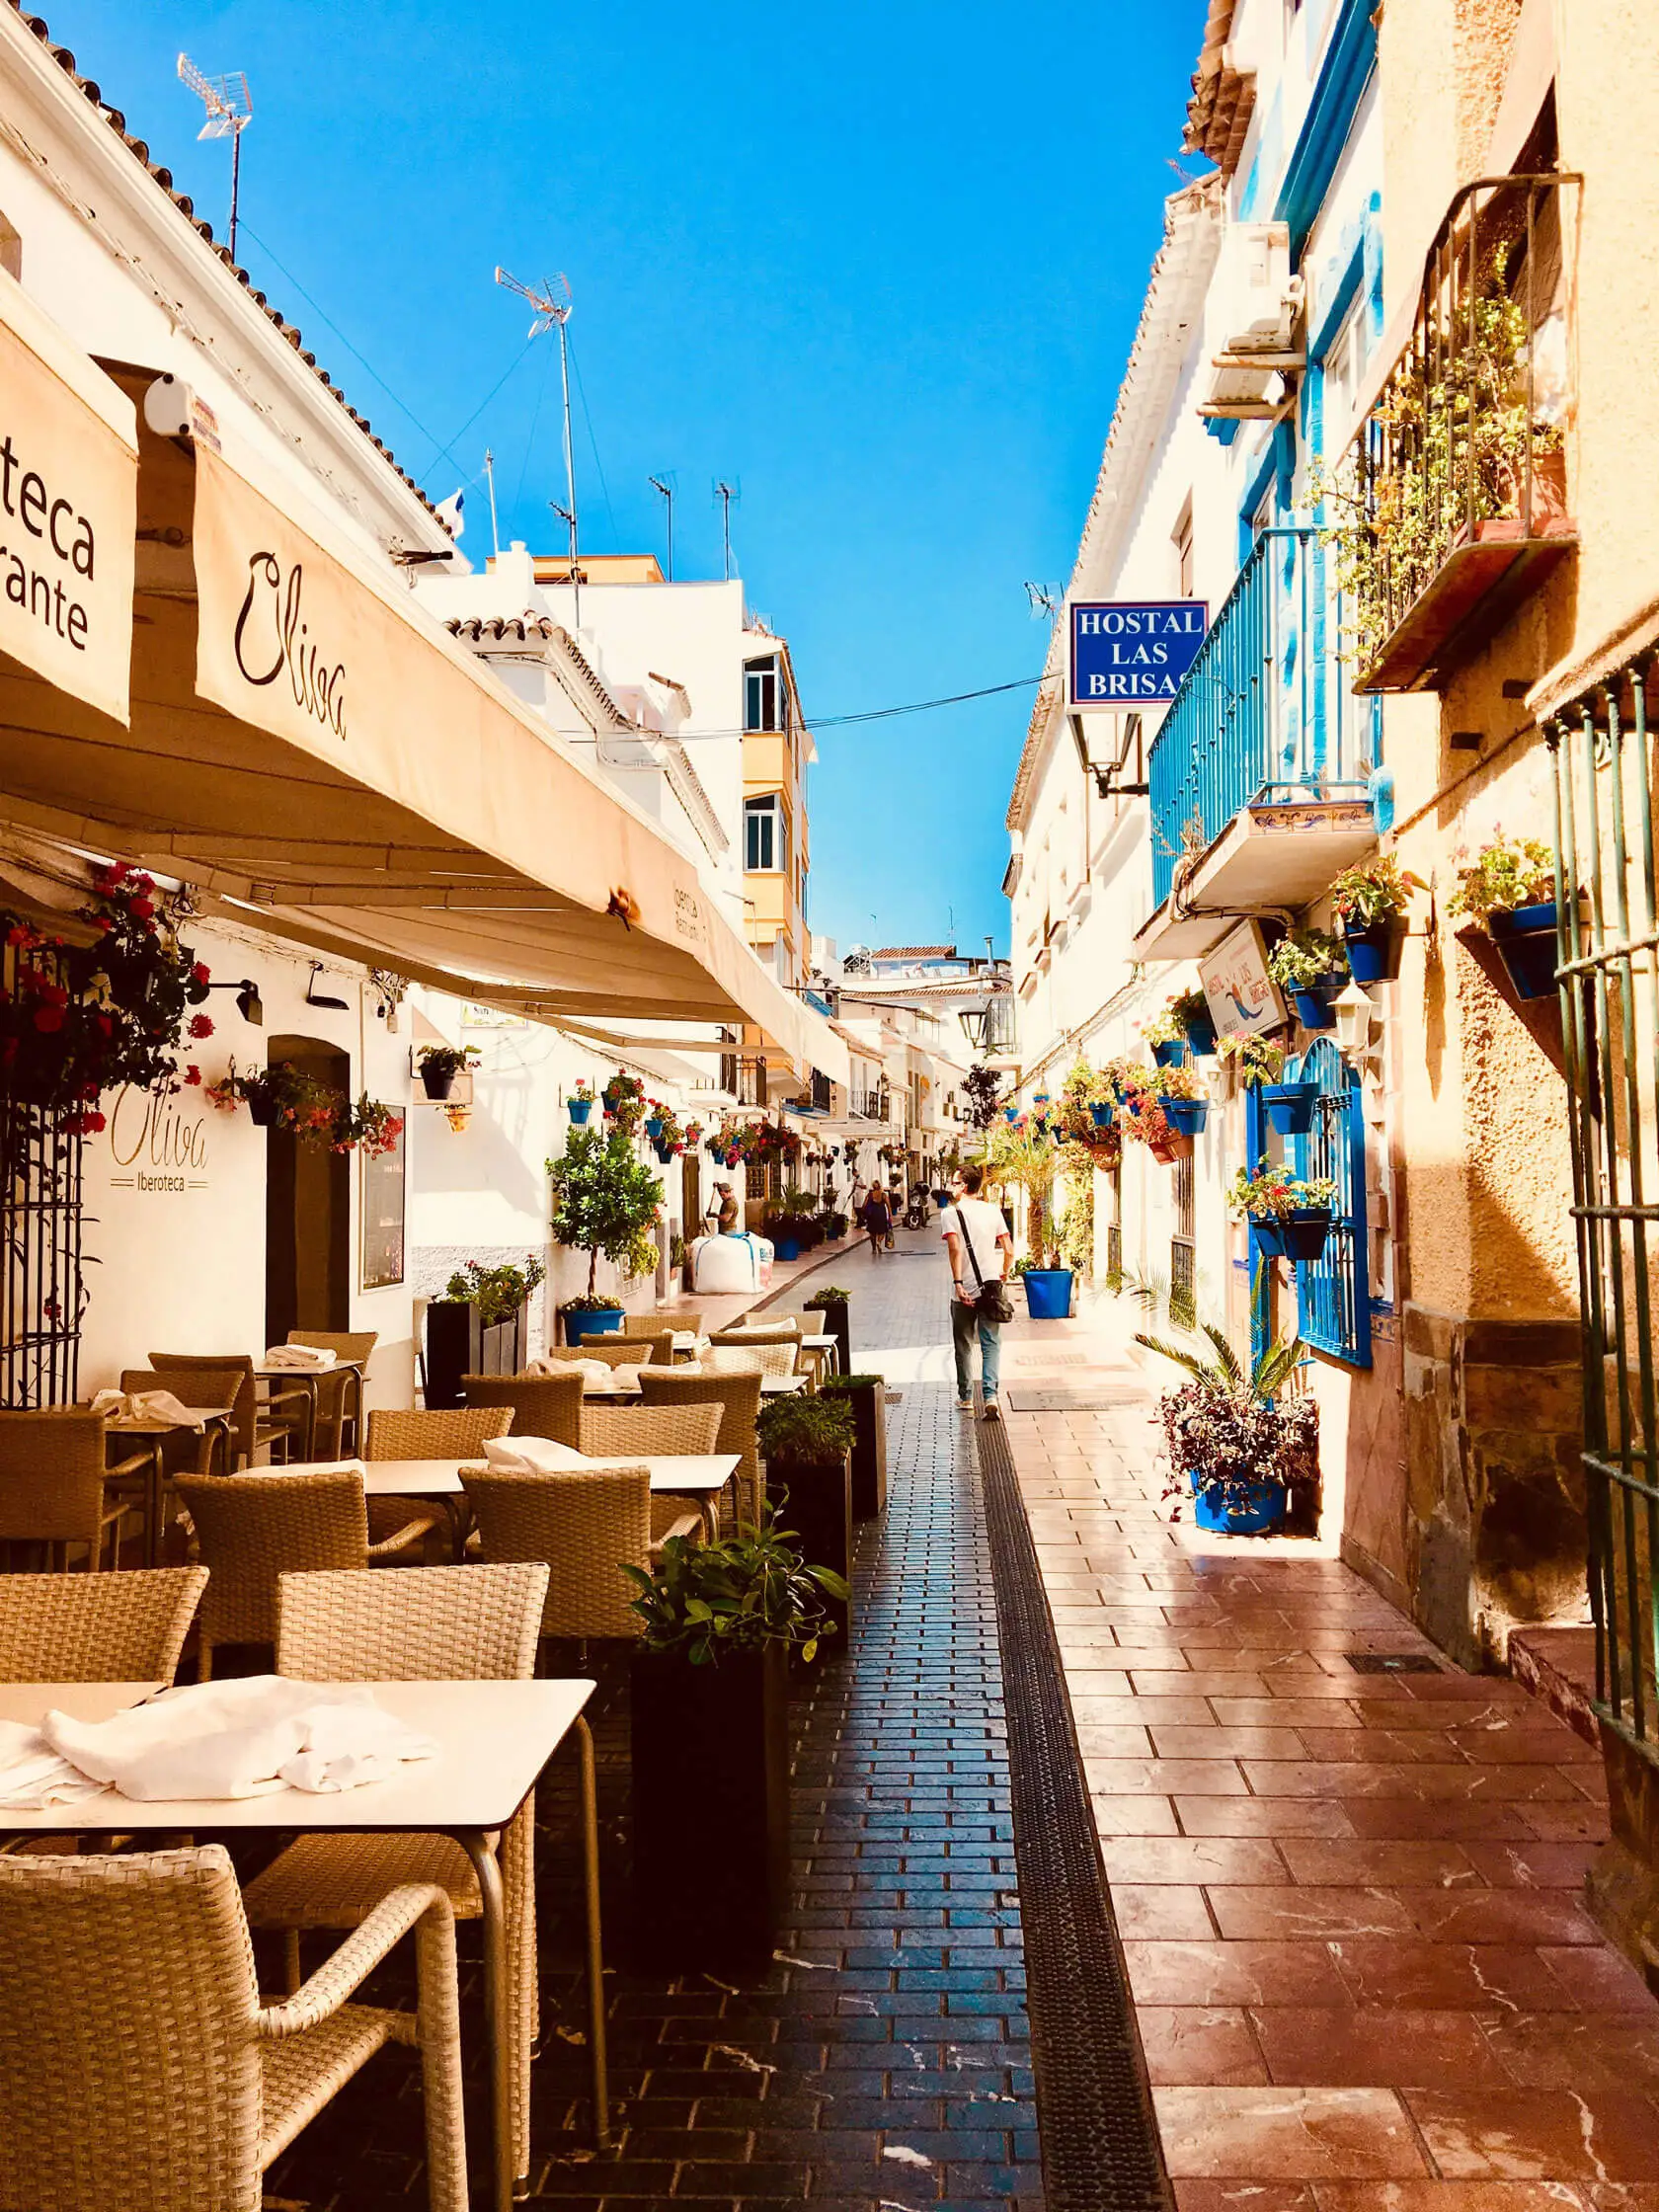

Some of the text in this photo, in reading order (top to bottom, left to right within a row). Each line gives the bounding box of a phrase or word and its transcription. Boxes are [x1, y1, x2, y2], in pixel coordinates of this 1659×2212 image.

[0, 435, 95, 582] teca
[0, 545, 88, 651] ante
[234, 550, 347, 742] Oliva
[1079, 611, 1203, 635] HOSTAL
[1111, 642, 1169, 665] LAS
[111, 1071, 208, 1169] Oliva
[137, 1170, 185, 1192] Iberoteca
